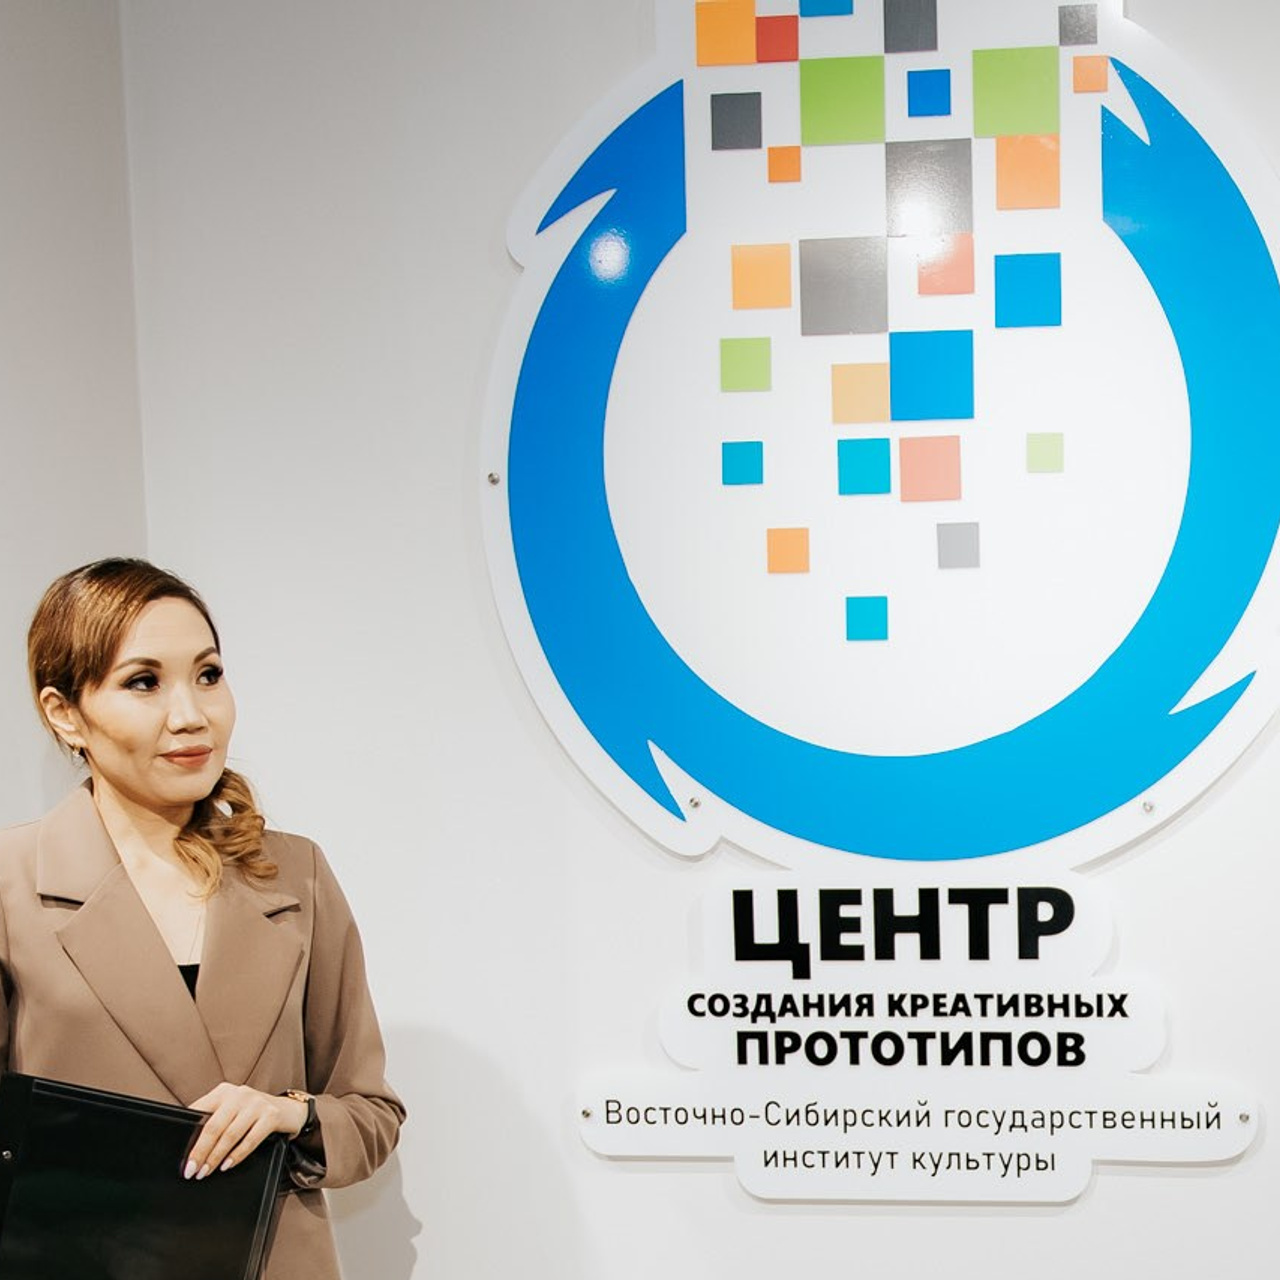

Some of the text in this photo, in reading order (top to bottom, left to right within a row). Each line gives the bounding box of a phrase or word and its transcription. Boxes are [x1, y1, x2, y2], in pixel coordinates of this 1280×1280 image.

[732, 886, 1075, 981] ЦЕНТР
[686, 992, 1129, 1025] СОЗДАНИЯ КРЕАТИВНЫХ
[736, 1030, 1086, 1068] ПРОТОТИПОВ
[605, 1099, 1221, 1136] Восточно-Сибирский государственный
[763, 1150, 1055, 1179] институт культуры
